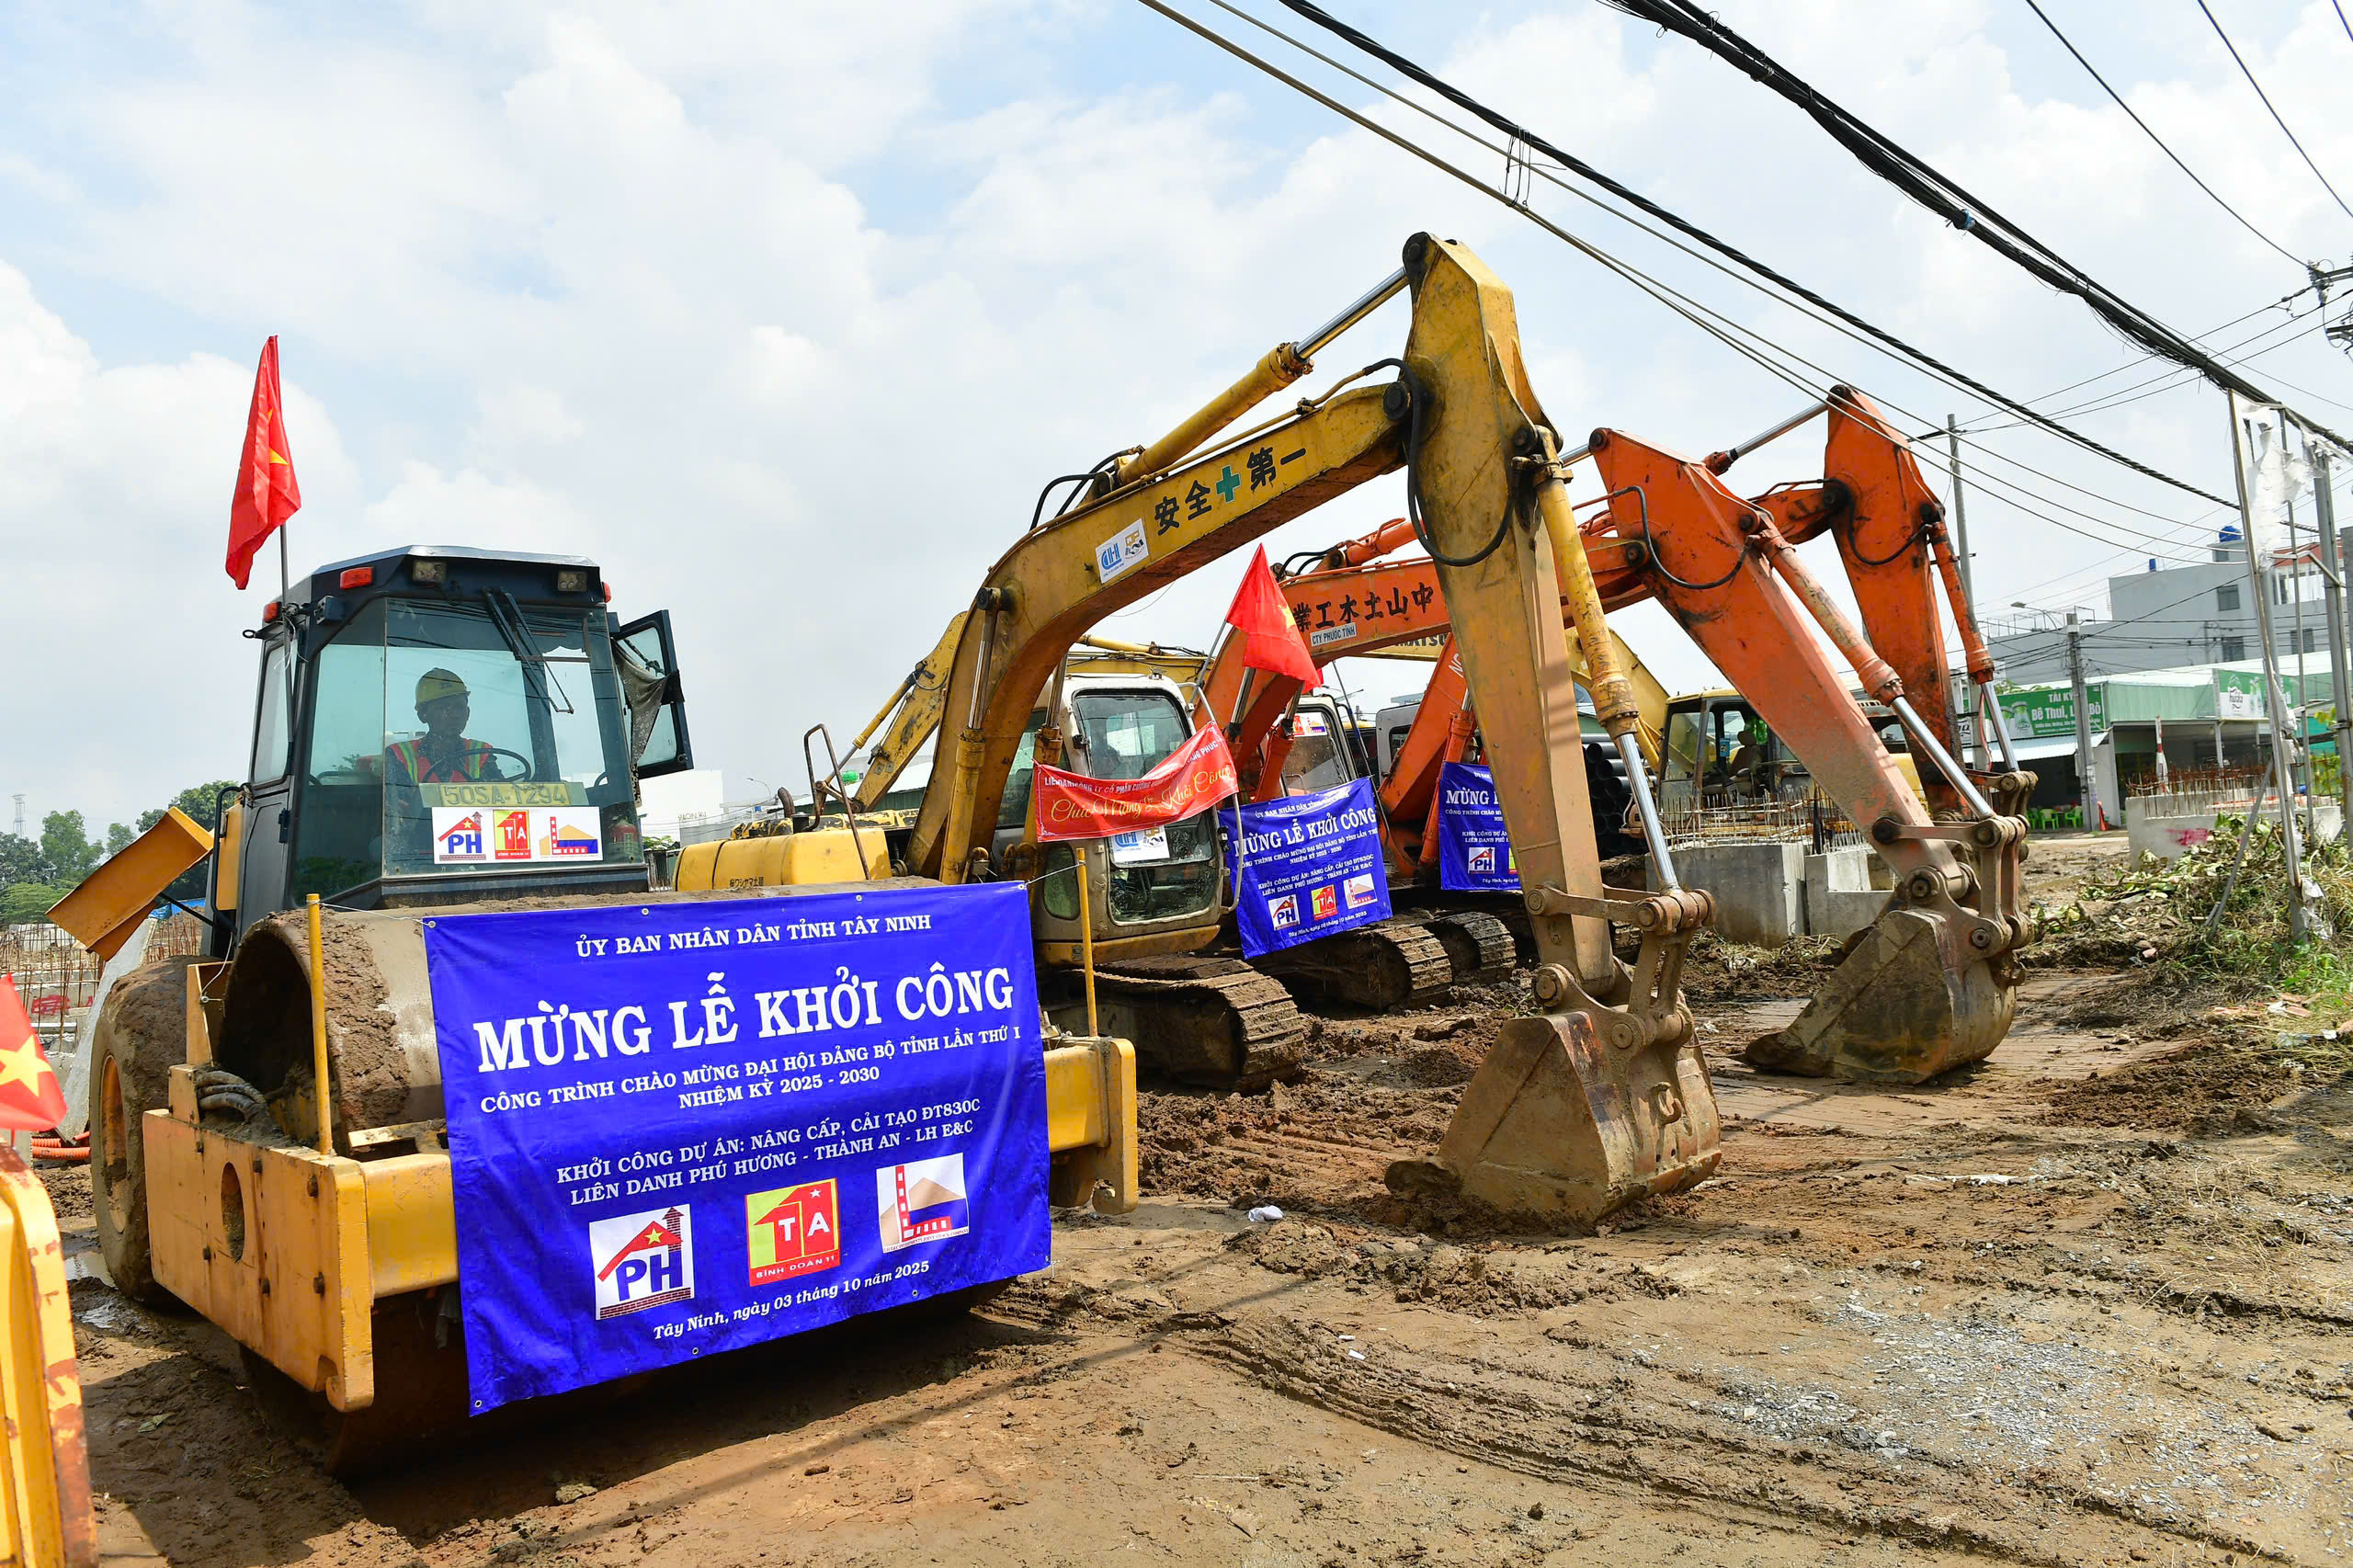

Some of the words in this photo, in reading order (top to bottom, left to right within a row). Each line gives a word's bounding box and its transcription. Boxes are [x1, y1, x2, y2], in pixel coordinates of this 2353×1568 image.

[1312, 635, 1323, 644] CTY
[1446, 787, 1490, 805] MỪNG
[448, 834, 483, 854] PH
[1233, 831, 1281, 857] MỪNG
[1283, 819, 1304, 845] LỄ
[1306, 812, 1339, 839] KHỞI
[1340, 808, 1376, 830] CÔNG
[1474, 859, 1493, 869] PH
[1277, 883, 1293, 892] DANH
[576, 934, 608, 958] ỦY
[616, 935, 661, 955] BAN
[669, 926, 730, 950] NHÂN
[736, 923, 780, 945] DÂN
[787, 918, 836, 940] TỈNH
[841, 915, 880, 936] TÂY
[885, 915, 931, 932] NINH
[1277, 909, 1297, 925] PH
[472, 999, 653, 1073] MỪNG
[668, 971, 739, 1050] LỄ
[755, 966, 882, 1039] KHỞI
[895, 961, 1014, 1021] CÔNG
[481, 1091, 542, 1114] CÔNG
[547, 1081, 615, 1104] TRÌNH
[620, 1071, 676, 1094] CHÀO
[683, 1064, 739, 1085] MỪNG
[745, 1059, 778, 1077] ĐẠI
[782, 1051, 816, 1073] HỘI
[821, 1045, 869, 1066] ĐẢNG
[873, 1040, 895, 1060] BỘ
[900, 1036, 939, 1055] TỈNH
[943, 1028, 973, 1049] LẦN
[978, 1025, 1008, 1044] THỨ
[1014, 1026, 1021, 1040] I
[678, 1085, 744, 1108] NHIỆM
[749, 1079, 774, 1098] KỲ
[780, 1074, 823, 1093] 2025
[839, 1066, 880, 1085] 2030
[557, 1156, 612, 1184] KHỞI
[618, 1151, 674, 1173] CÔNG
[679, 1142, 708, 1164] DỰ
[713, 1138, 745, 1157] ÁN:
[750, 1129, 801, 1151] NÂNG
[806, 1118, 846, 1140] CẤP,
[850, 1111, 881, 1132] CẢI
[885, 1109, 917, 1128] TẠO
[922, 1098, 981, 1120] ĐT830C
[570, 1182, 620, 1206] LIÊN
[626, 1171, 683, 1195] DANH
[689, 1160, 727, 1184] PHÚ
[734, 1152, 797, 1176] HƯƠNG
[813, 1138, 873, 1160] THÀNH
[878, 1132, 900, 1148] AN
[915, 1126, 938, 1142] LH
[942, 1120, 973, 1137] E&C
[615, 1250, 683, 1301] PH
[654, 1323, 684, 1339] Tây
[687, 1312, 729, 1332] Ninh,
[733, 1301, 770, 1321] ngày
[774, 1294, 792, 1310] 03
[796, 1285, 838, 1304] tháng
[843, 1278, 860, 1293] 10
[864, 1272, 892, 1288] năm
[895, 1261, 929, 1278] 2025
